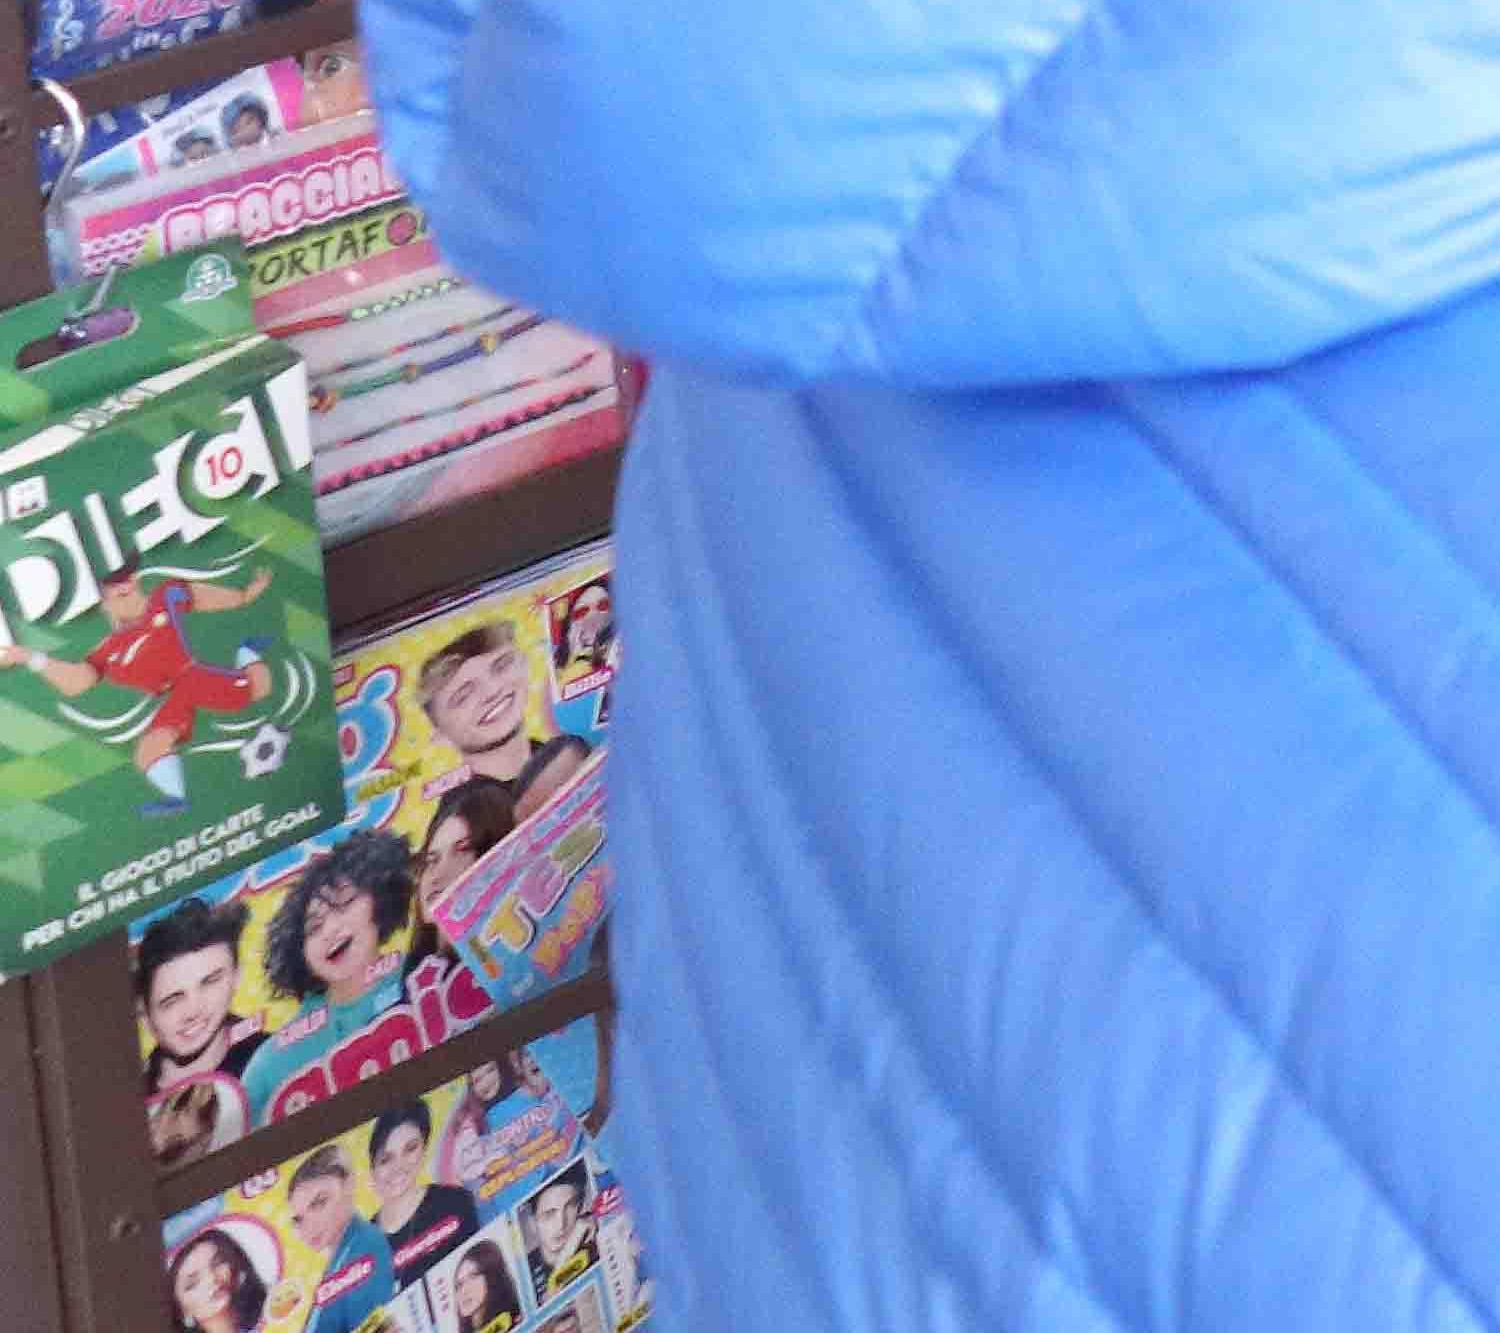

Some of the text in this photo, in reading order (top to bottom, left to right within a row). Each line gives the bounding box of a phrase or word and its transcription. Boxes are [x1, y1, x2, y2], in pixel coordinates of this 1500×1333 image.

[102, 805, 264, 892] GIOCO CARTE
[265, 803, 320, 837] GOAL
